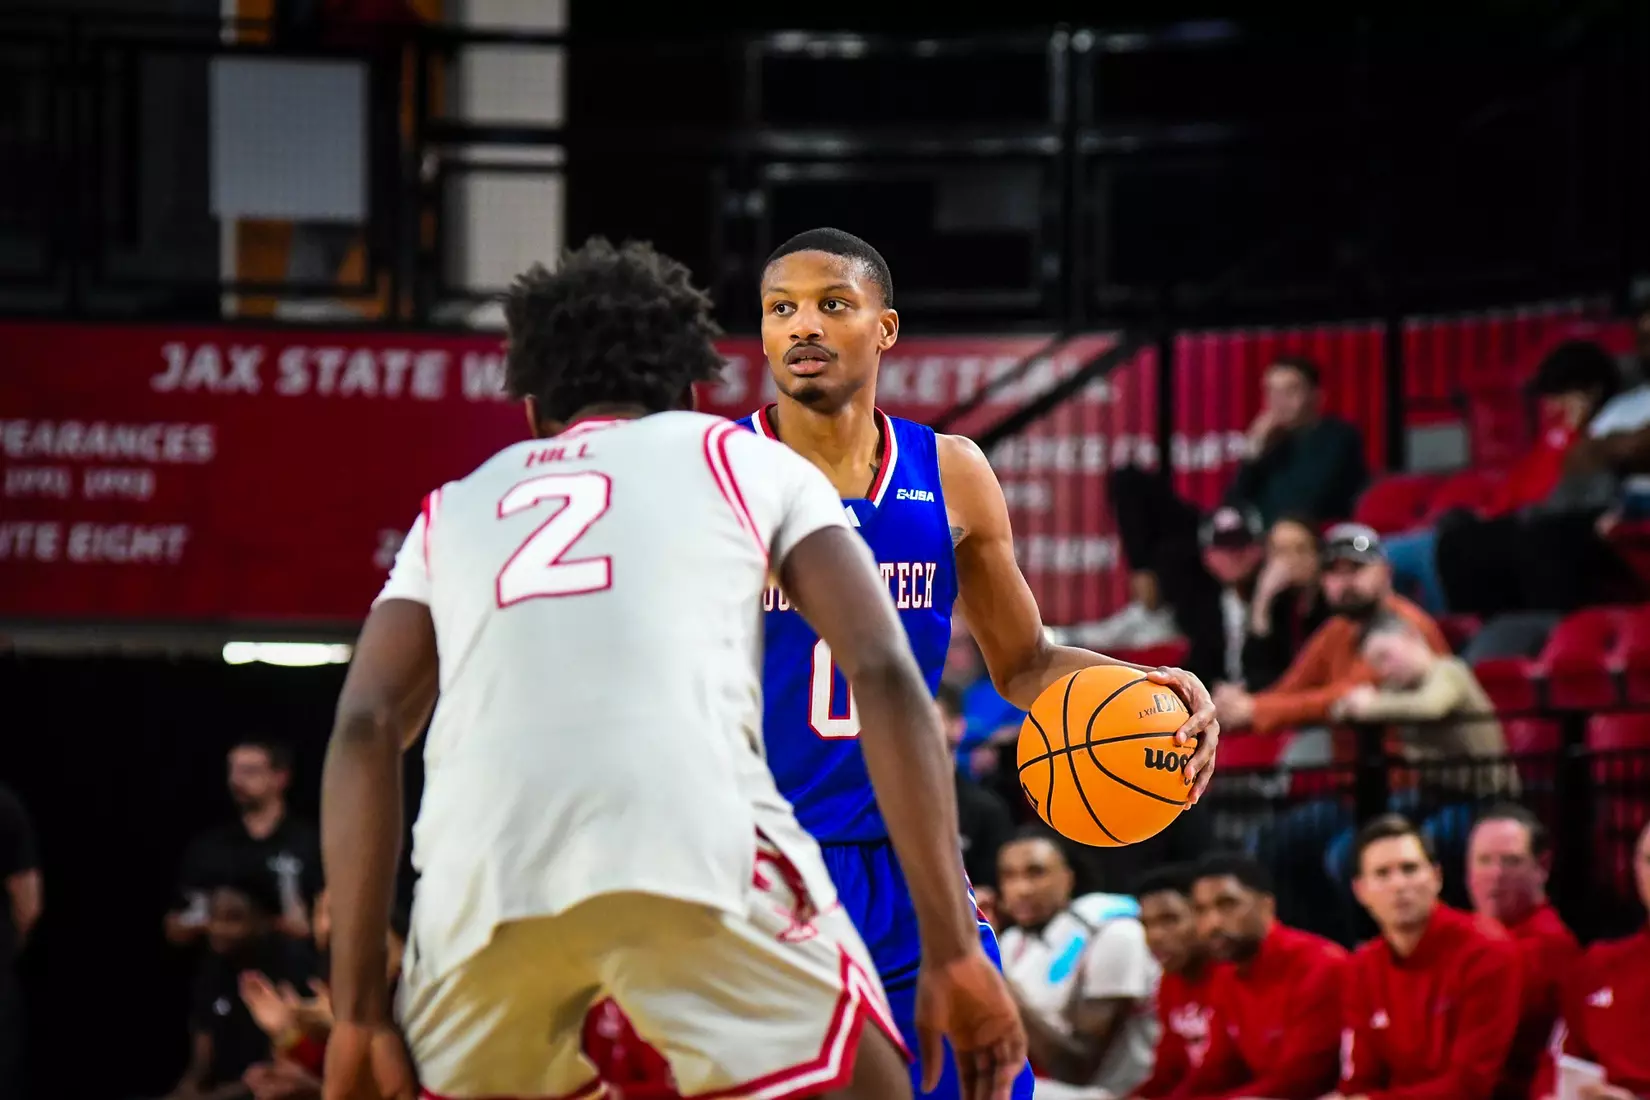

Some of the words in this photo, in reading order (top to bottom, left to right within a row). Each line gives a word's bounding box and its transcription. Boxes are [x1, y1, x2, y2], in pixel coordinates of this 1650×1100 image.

[151, 342, 263, 394] JAX
[275, 348, 448, 399] STATE
[0, 418, 217, 463] EARANCES
[525, 443, 596, 469] HILL
[496, 469, 613, 609] 2
[879, 562, 937, 609] TECH
